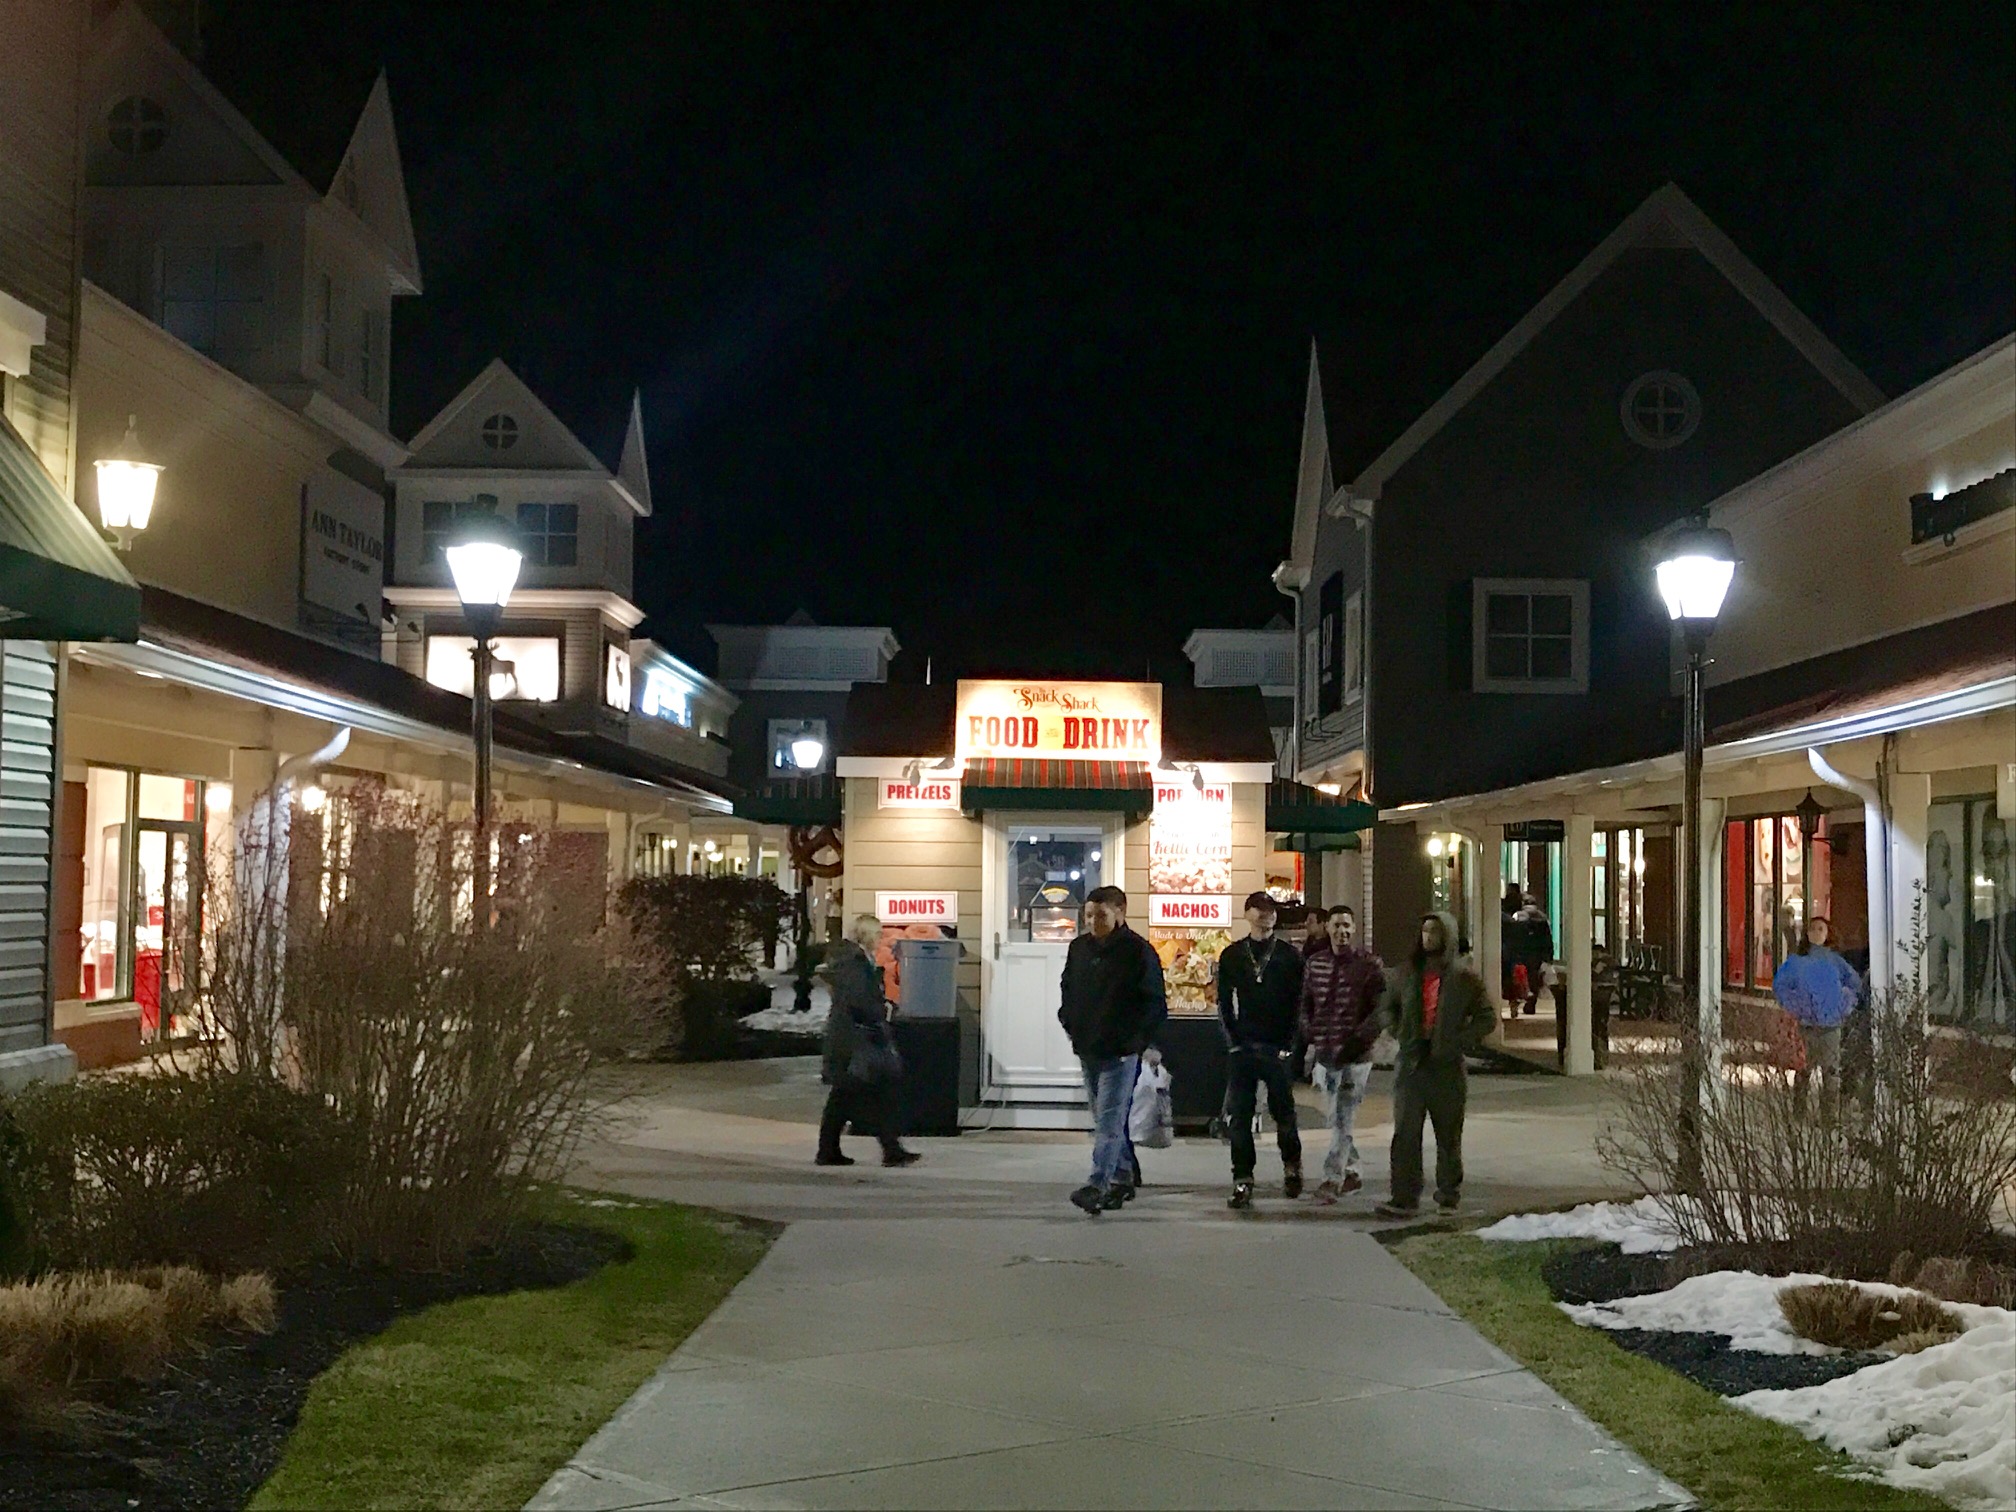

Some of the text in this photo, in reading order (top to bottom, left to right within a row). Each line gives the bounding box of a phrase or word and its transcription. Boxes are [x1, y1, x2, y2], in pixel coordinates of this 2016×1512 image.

[311, 509, 336, 539] ANN
[339, 522, 383, 562] TAYLOR
[1013, 686, 1103, 713] Snack Shack
[969, 716, 1150, 749] FOOD DRINK
[888, 899, 945, 915] DONUTS
[1161, 903, 1220, 919] NACHOS
[1153, 931, 1174, 939] Made
[1175, 931, 1183, 939] to
